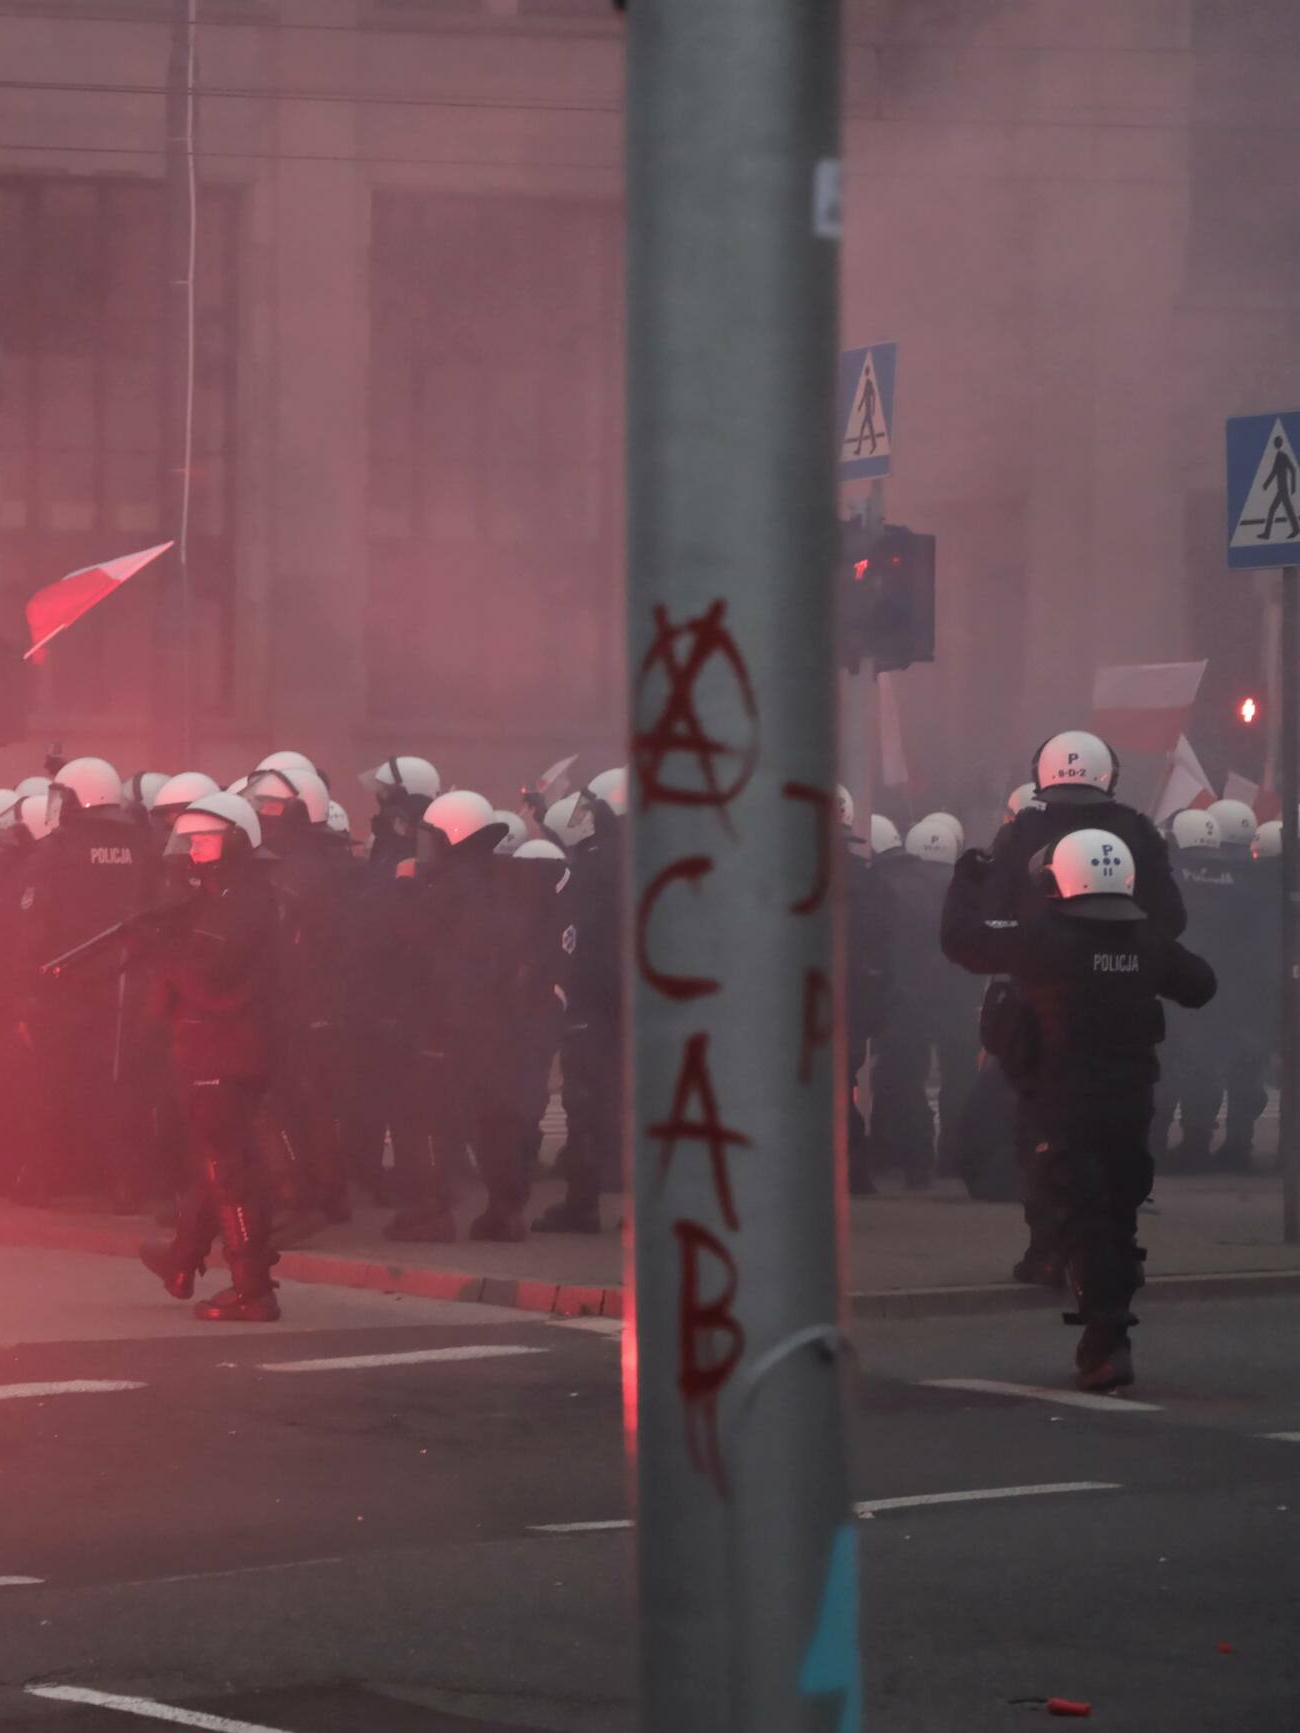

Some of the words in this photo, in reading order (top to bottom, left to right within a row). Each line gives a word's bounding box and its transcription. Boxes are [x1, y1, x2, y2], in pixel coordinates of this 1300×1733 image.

[1068, 753, 1079, 764] P
[91, 847, 132, 864] POLICJA
[1102, 844, 1113, 856] P
[1093, 953, 1140, 972] POLICJA
